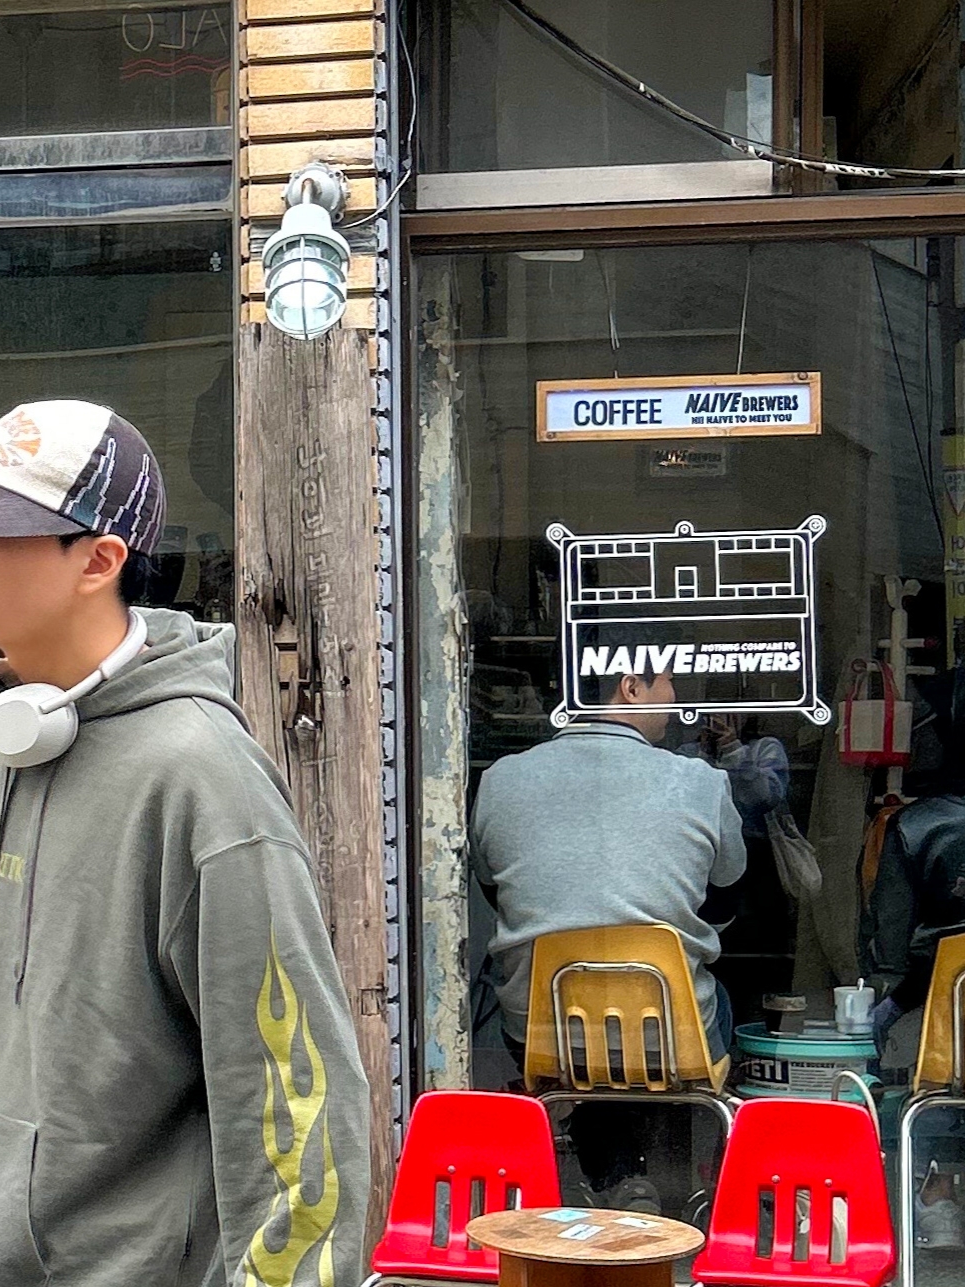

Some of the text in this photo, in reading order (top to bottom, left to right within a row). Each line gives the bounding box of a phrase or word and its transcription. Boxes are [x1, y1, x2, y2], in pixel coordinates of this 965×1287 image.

[574, 392, 800, 426] COFFEE NAIVE BREWERS
[706, 415, 733, 424] NAIVE
[734, 415, 747, 423] TO
[749, 414, 771, 423] MEET
[772, 413, 793, 422] YOU
[580, 644, 695, 676] NAIVE
[694, 651, 801, 674] BREWERS
